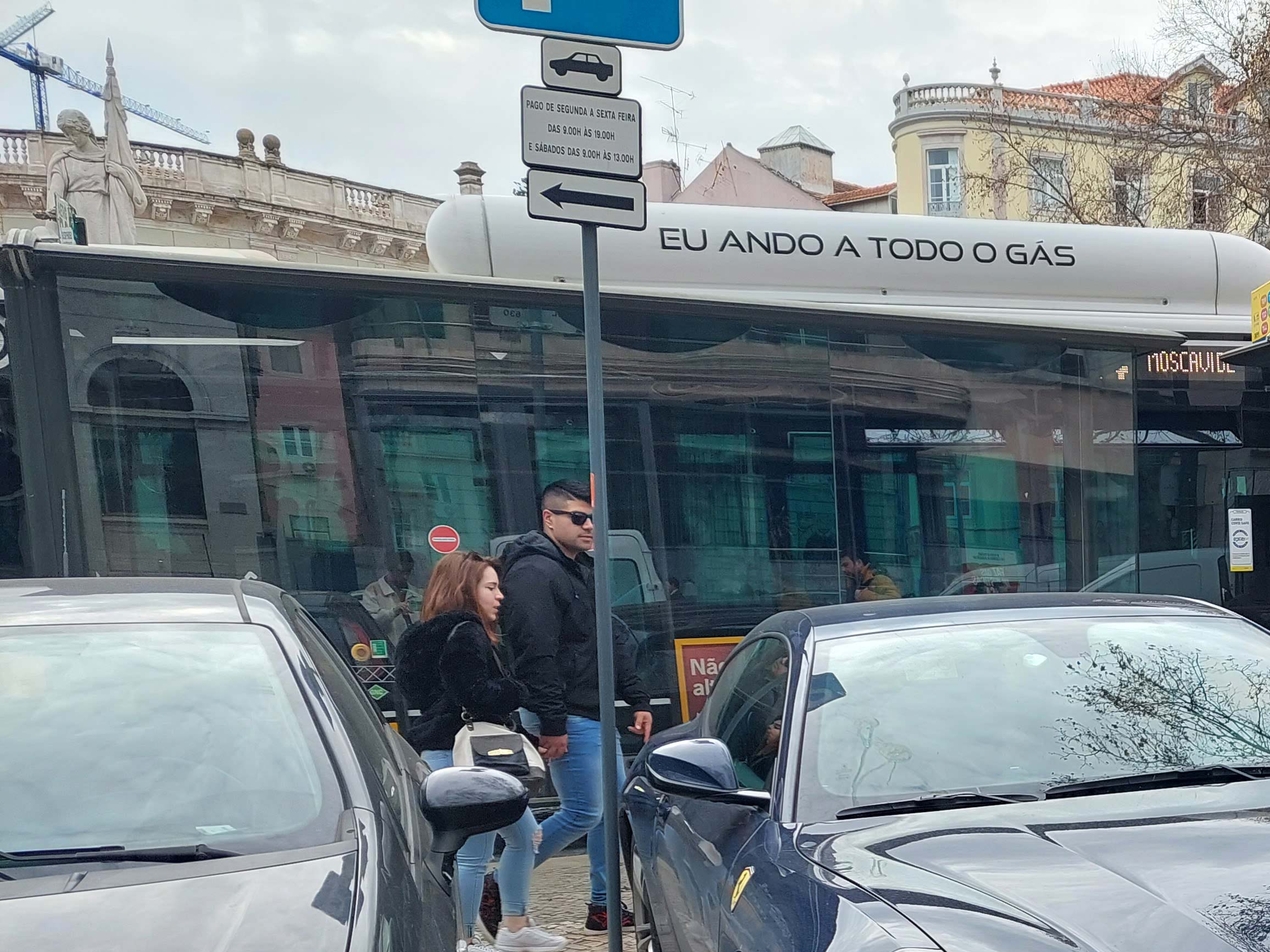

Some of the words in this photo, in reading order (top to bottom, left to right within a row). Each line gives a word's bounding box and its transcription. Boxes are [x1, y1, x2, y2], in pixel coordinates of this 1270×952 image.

[526, 100, 543, 111] PAGO
[546, 102, 555, 112] DE
[556, 104, 588, 116] SEGUNDA
[589, 107, 595, 117] A
[596, 109, 616, 119] SEXTA
[618, 112, 636, 122] FEIRA
[547, 124, 561, 133] DAS
[562, 125, 581, 136] 9.00H
[594, 129, 615, 141] 19.00H
[528, 142, 533, 151] E
[535, 141, 565, 156] SÁBADOS
[567, 147, 581, 157] DAS
[582, 148, 601, 160] 9.00H
[613, 153, 635, 164] 13.00H
[659, 227, 708, 251] EU
[719, 230, 825, 256] ANDO
[833, 235, 861, 258] A
[868, 236, 964, 262] TODO
[973, 241, 997, 264] O
[1005, 240, 1076, 267] GÁS
